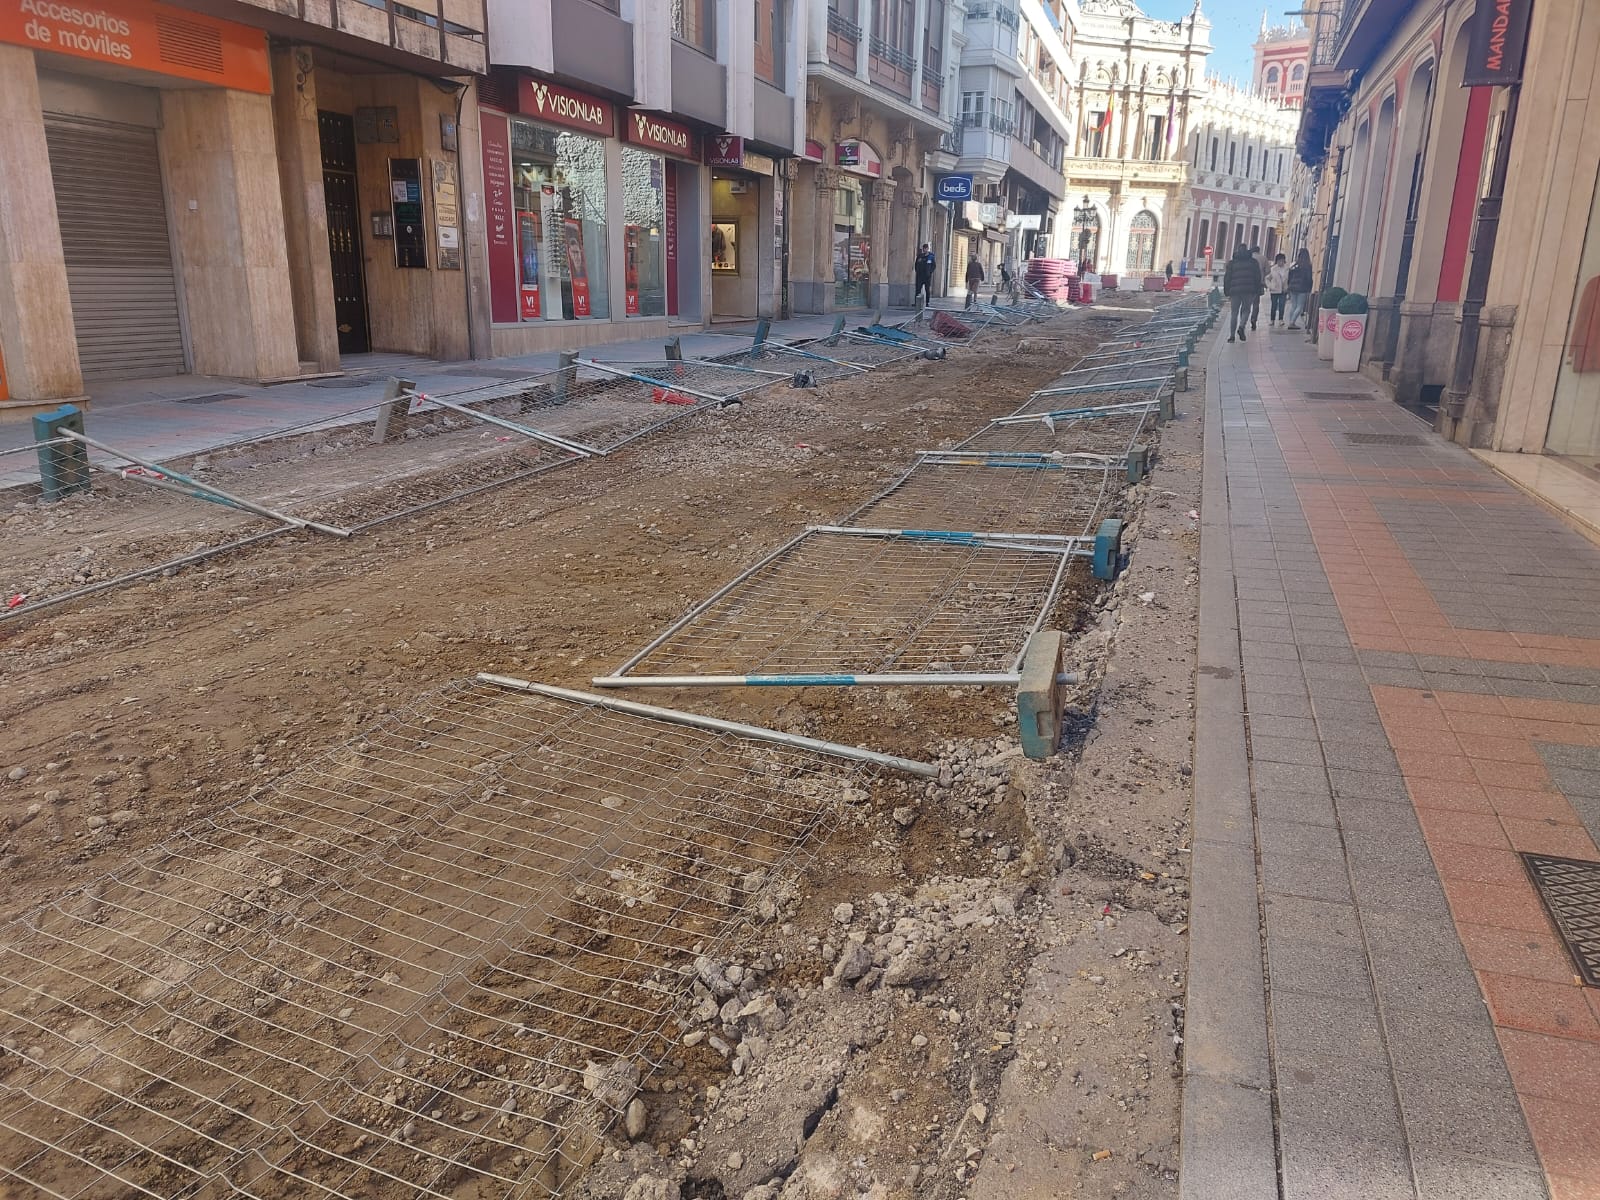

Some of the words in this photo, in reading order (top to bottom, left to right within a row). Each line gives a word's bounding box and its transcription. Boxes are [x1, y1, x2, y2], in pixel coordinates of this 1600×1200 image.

[20, 0, 130, 36] Accesorios
[1486, 0, 1512, 70] MANDA
[25, 19, 52, 43] de
[58, 30, 132, 60] móviles
[546, 91, 603, 125] VISIONLAB
[646, 121, 687, 148] VISIONLAB
[709, 157, 739, 165] VISIONLAB
